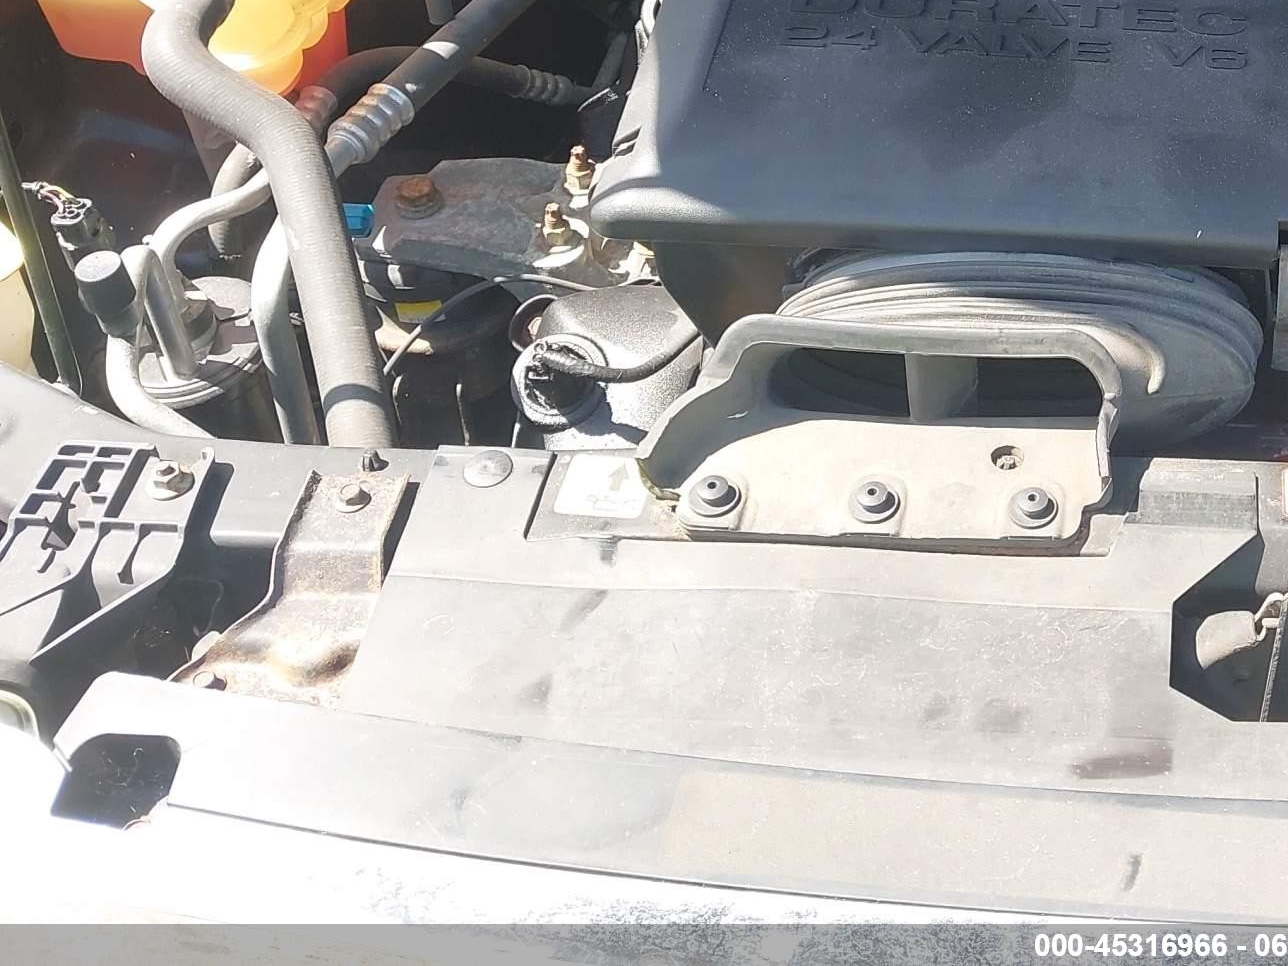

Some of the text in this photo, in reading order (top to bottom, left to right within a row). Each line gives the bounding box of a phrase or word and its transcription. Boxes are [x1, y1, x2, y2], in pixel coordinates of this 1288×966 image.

[780, 25, 1249, 71] 24 VALVE V6
